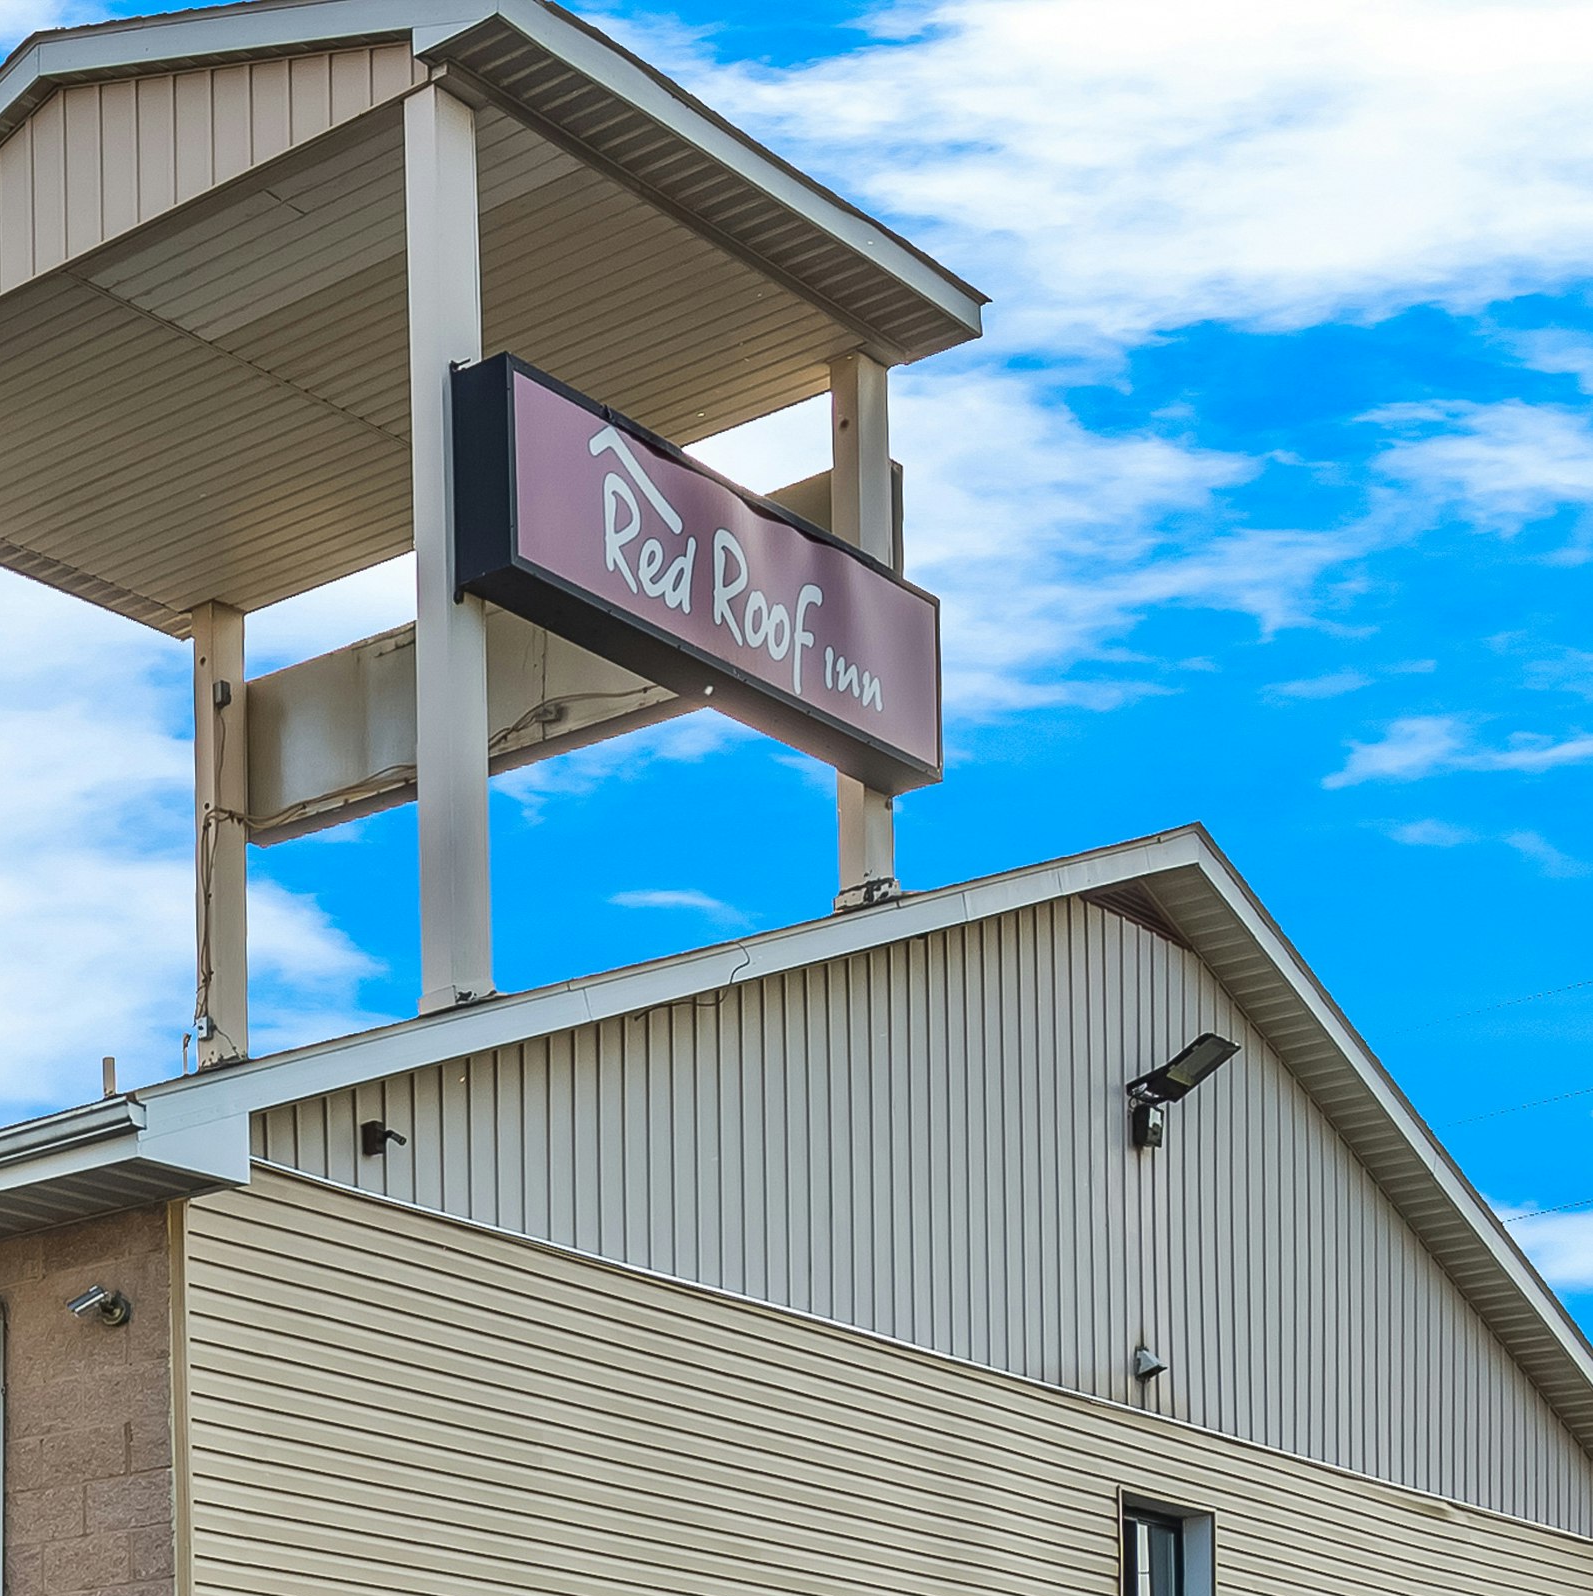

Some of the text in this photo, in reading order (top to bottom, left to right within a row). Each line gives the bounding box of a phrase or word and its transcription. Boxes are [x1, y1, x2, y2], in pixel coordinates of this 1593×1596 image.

[604, 472, 883, 712] Red Roof inn
